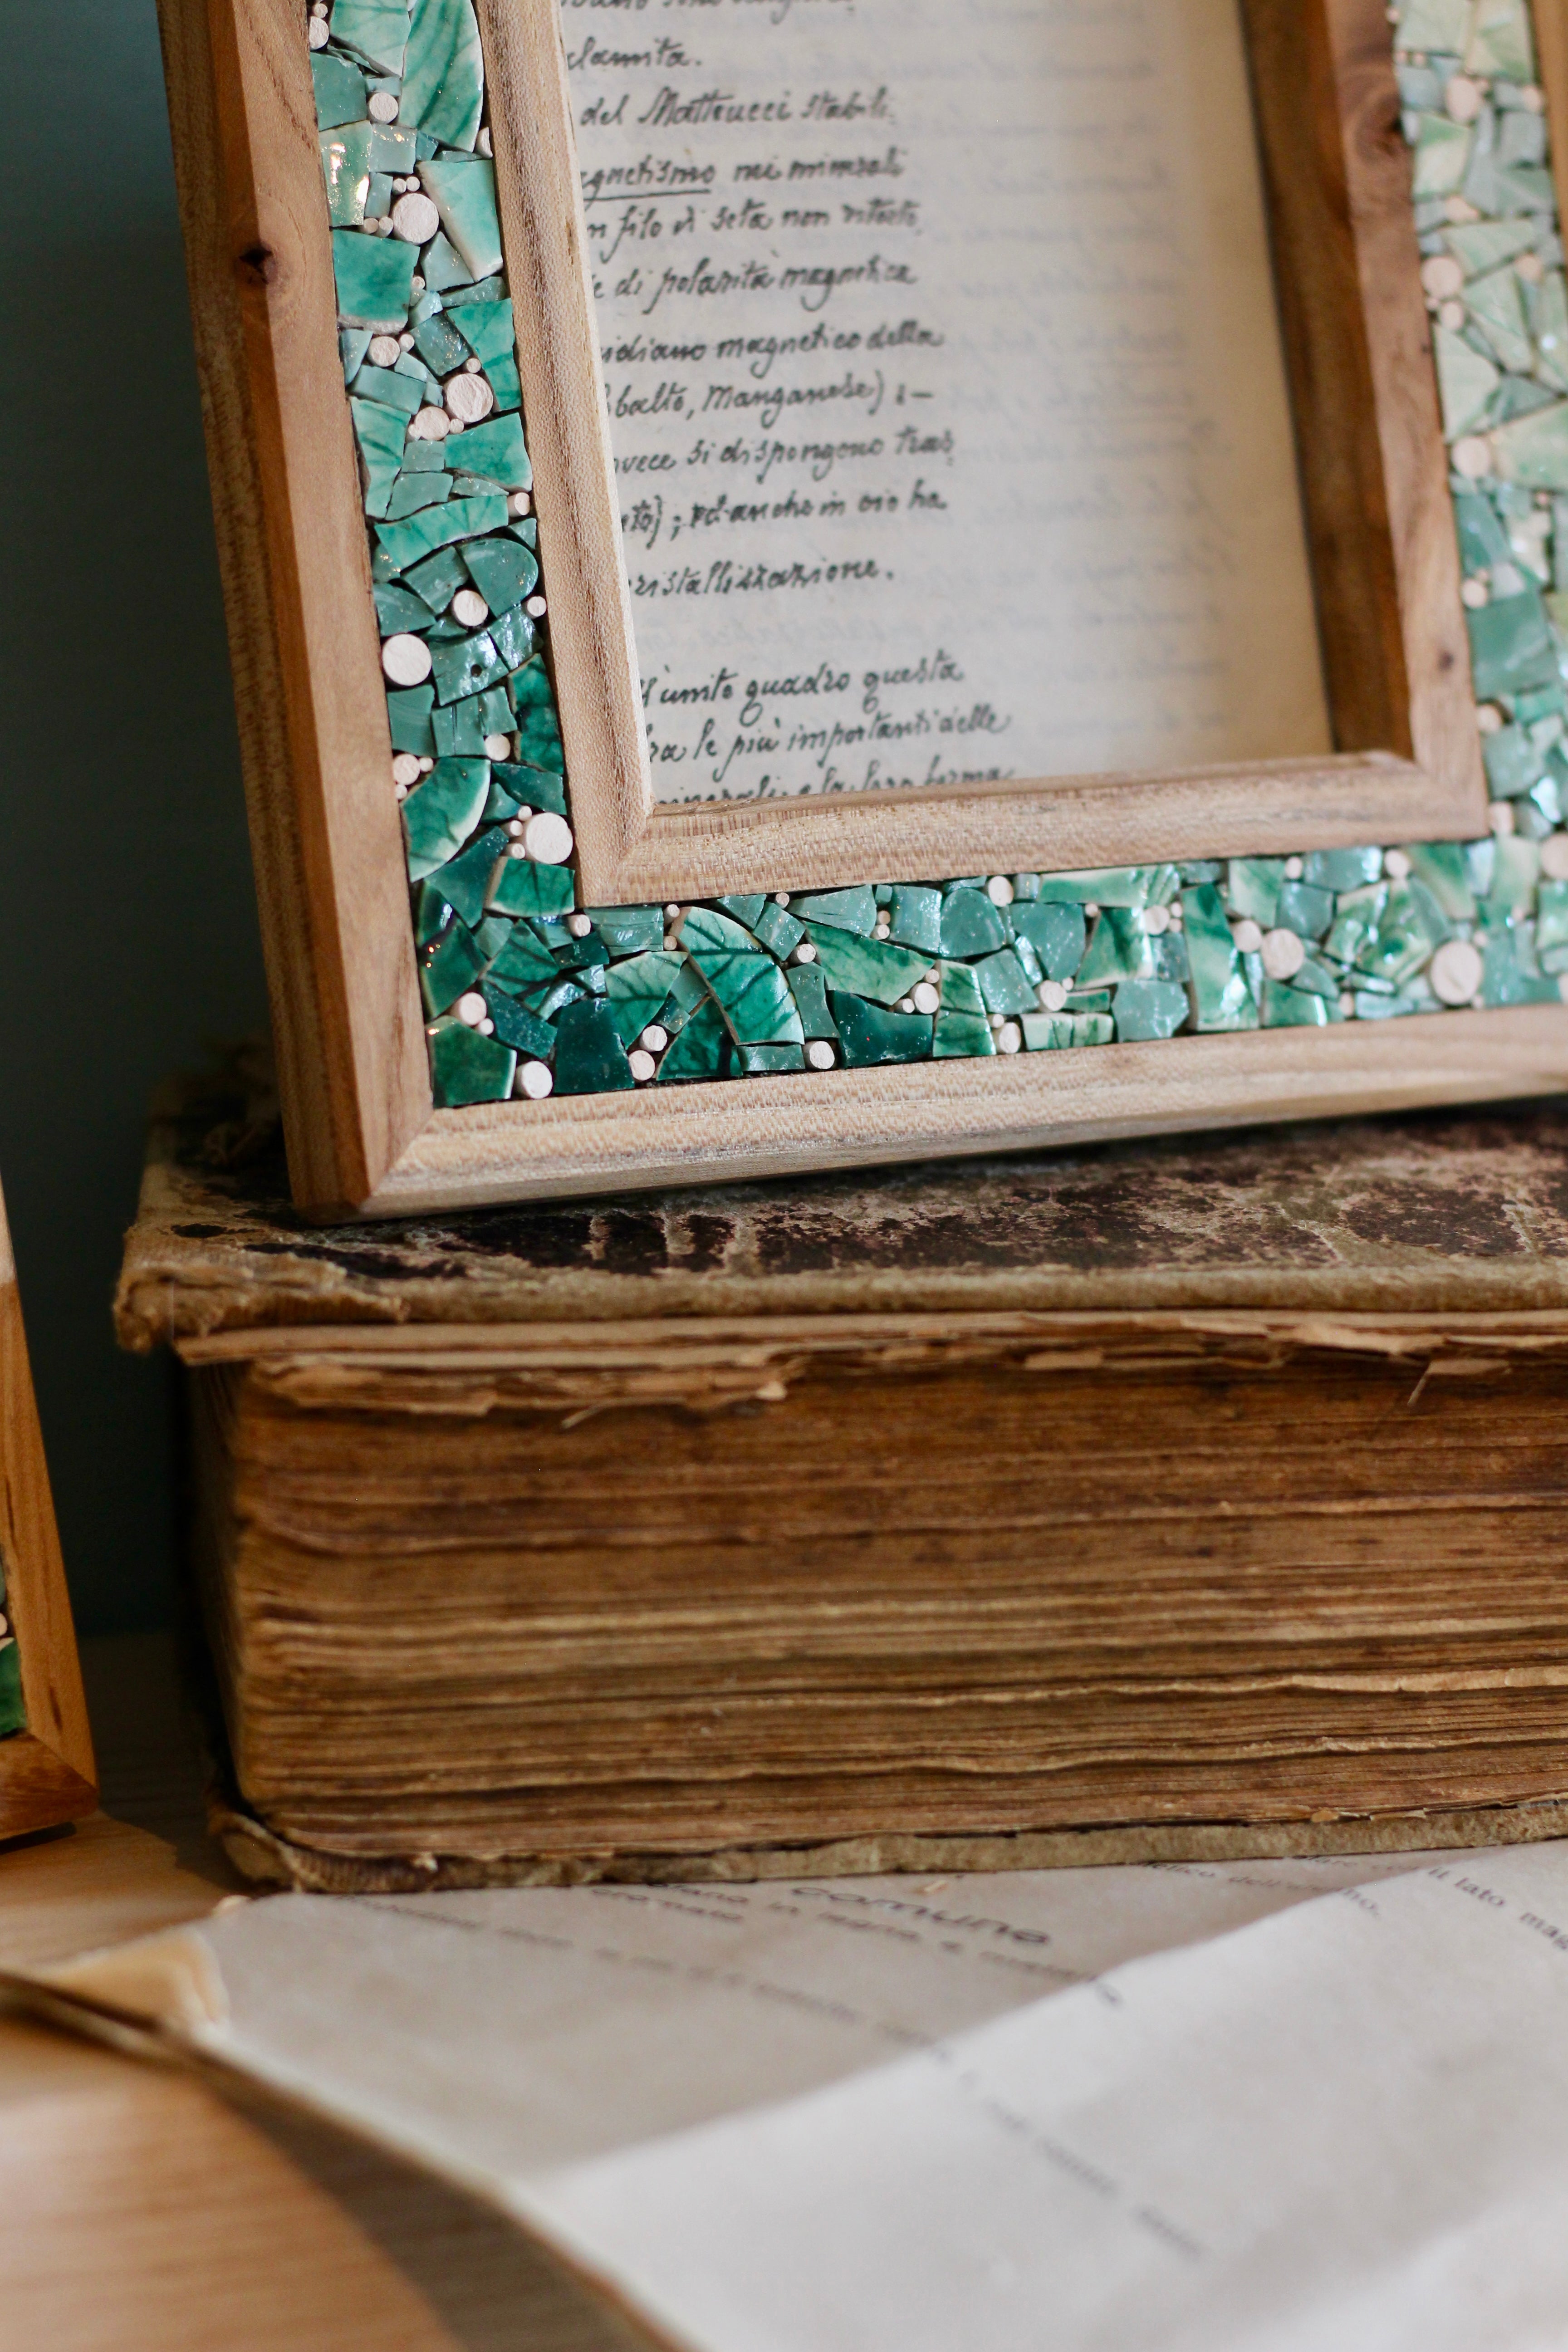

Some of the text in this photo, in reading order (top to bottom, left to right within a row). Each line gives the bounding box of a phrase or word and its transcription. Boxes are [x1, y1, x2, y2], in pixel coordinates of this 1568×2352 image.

[580, 93, 629, 126] del
[637, 85, 792, 126] Matteucci
[599, 204, 662, 264] filo
[711, 198, 773, 230] seta
[782, 209, 830, 227] non
[615, 268, 652, 296] di
[779, 253, 918, 311] magnetica
[601, 319, 944, 378] idiano magnetico della
[628, 558, 894, 598] ristallizzazione.
[739, 662, 851, 727] quadro
[862, 648, 965, 713] questa
[693, 718, 717, 760] le
[787, 708, 938, 769] importanti
[940, 703, 1011, 735] delle
[792, 1886, 1050, 1945] comune
[1455, 1877, 1505, 1906] lato
